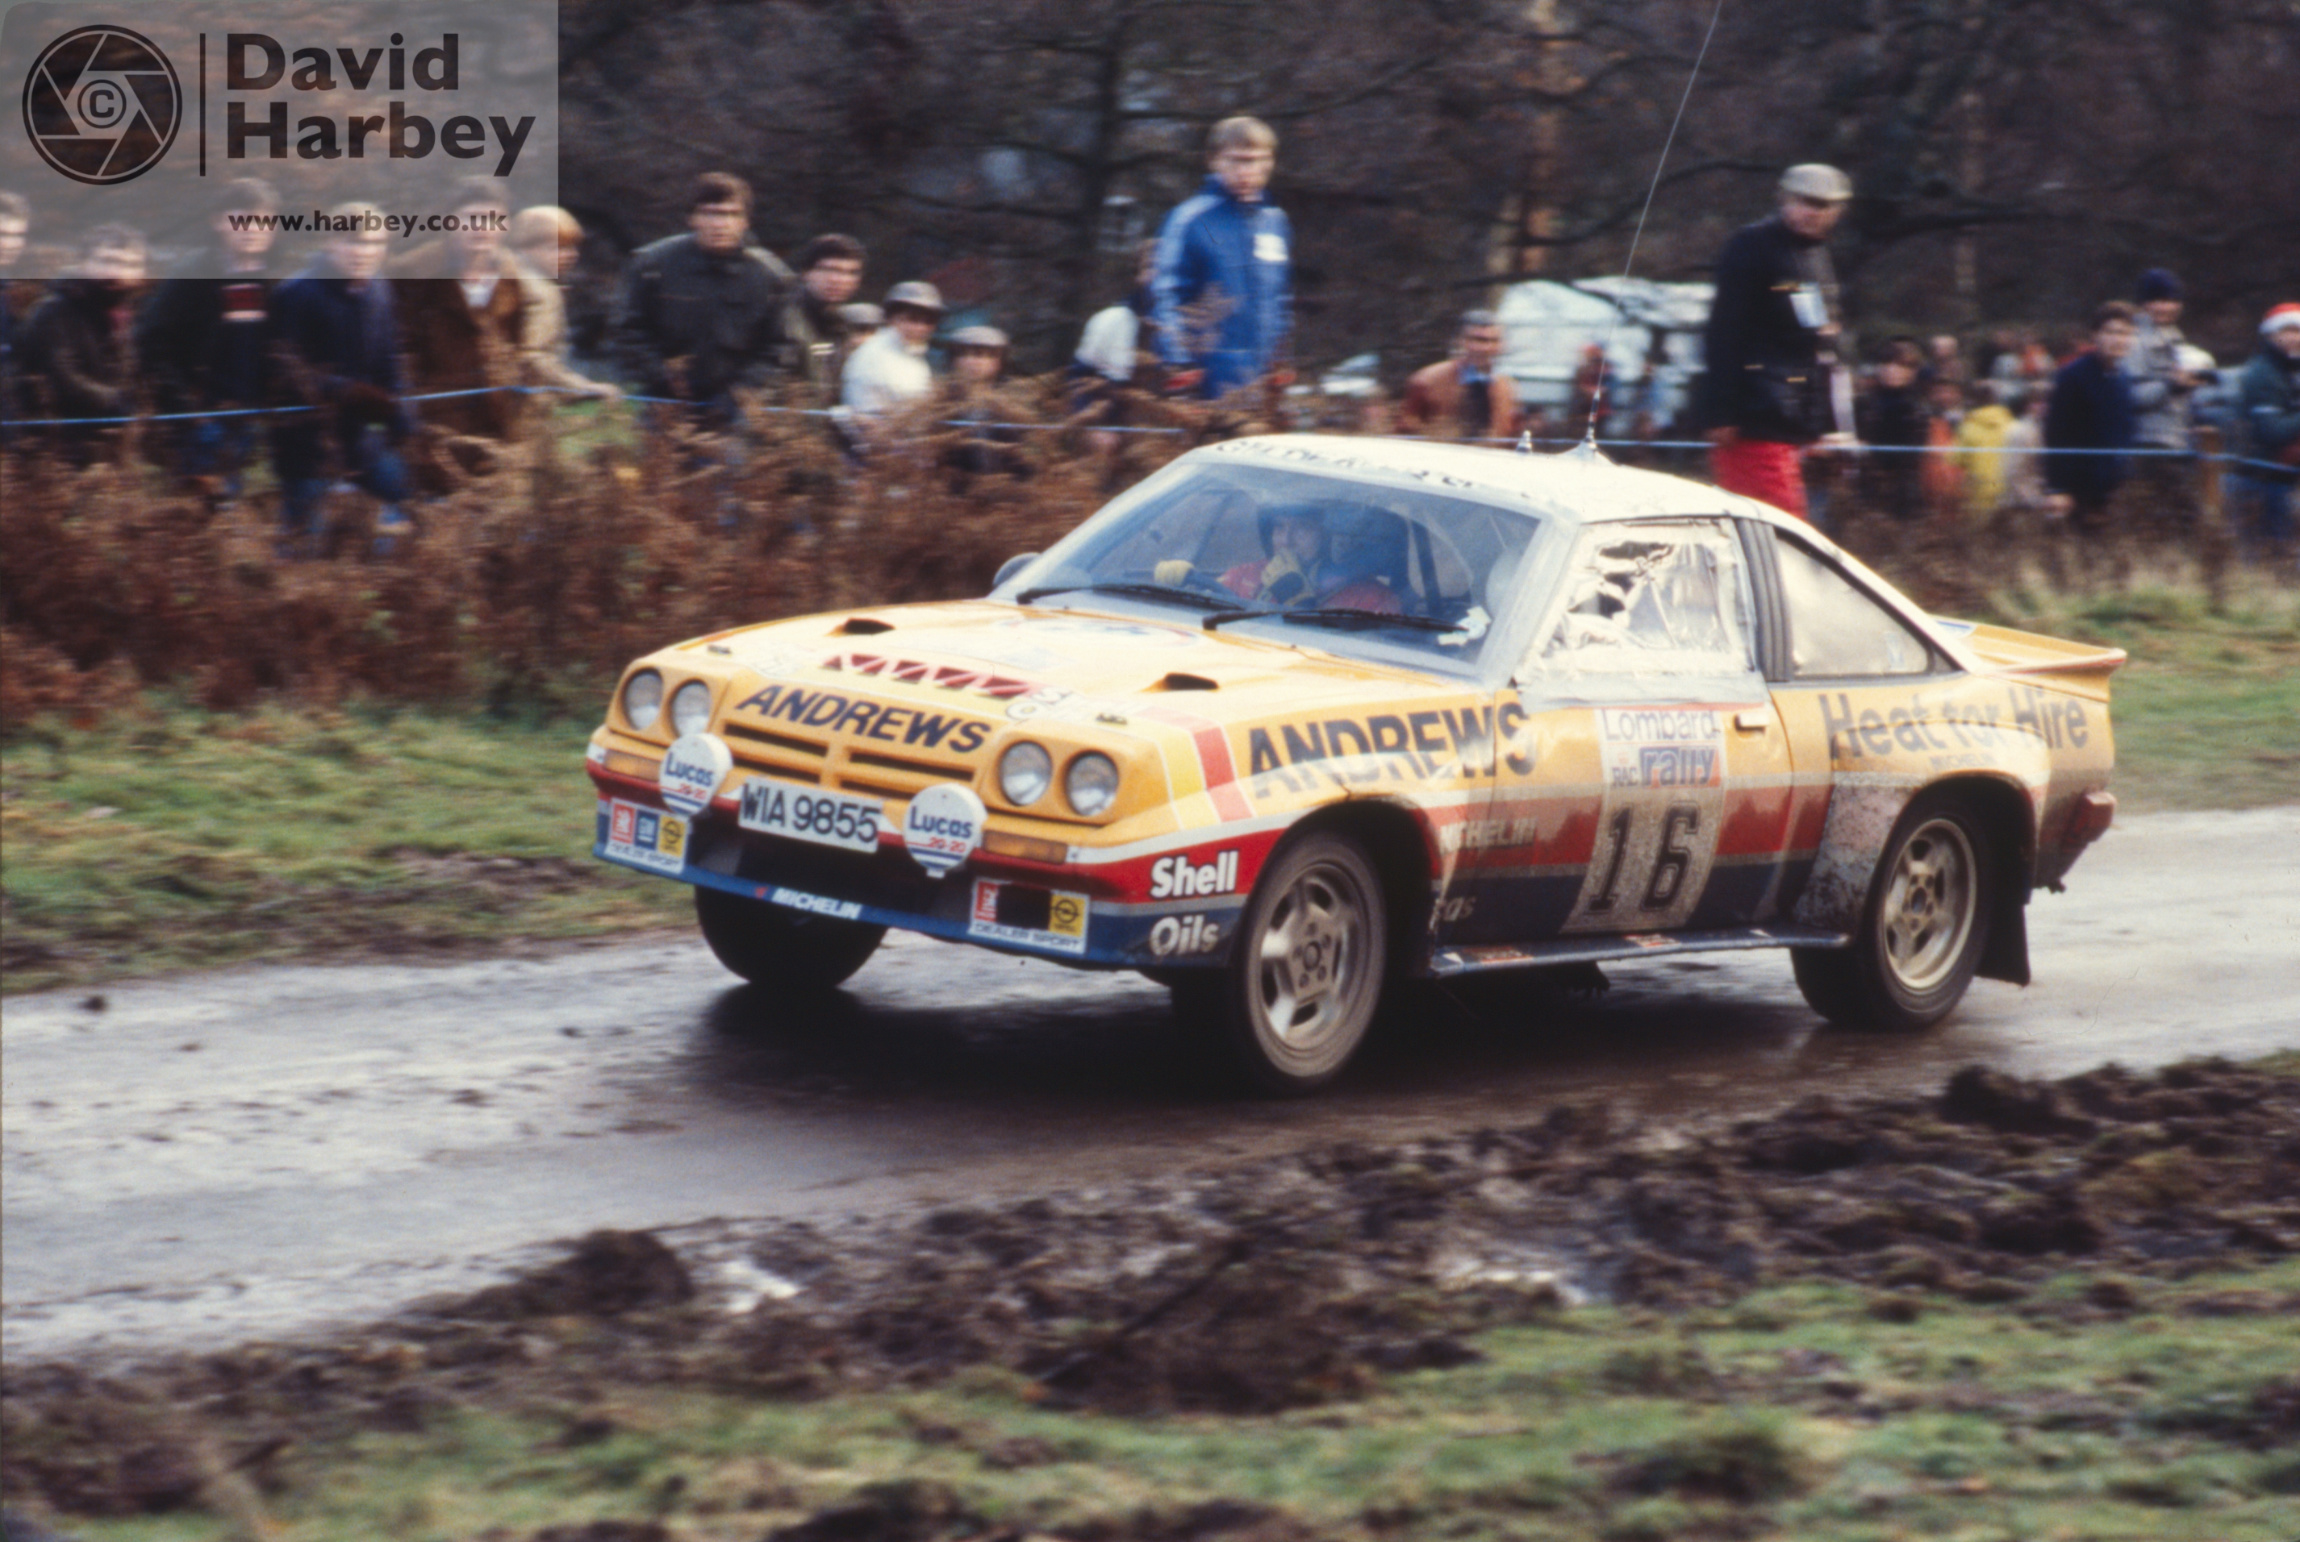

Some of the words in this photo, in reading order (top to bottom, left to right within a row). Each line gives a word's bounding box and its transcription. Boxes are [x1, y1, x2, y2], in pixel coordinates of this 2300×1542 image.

[735, 684, 992, 753] ANDREWS
[1601, 707, 1718, 741] Lombard
[1818, 692, 1946, 760] Heat
[1943, 697, 2005, 749] for
[2006, 685, 2089, 750] Hire
[665, 751, 713, 788] Lucas
[1249, 701, 1536, 799] ANDREWS
[1641, 747, 1715, 786] rally
[743, 781, 786, 828] WIA
[793, 795, 882, 844] 9855
[909, 805, 973, 839] Lucas
[1150, 849, 1239, 899] Shell
[1583, 800, 1704, 916] 16
[1150, 915, 1220, 957] Oils
